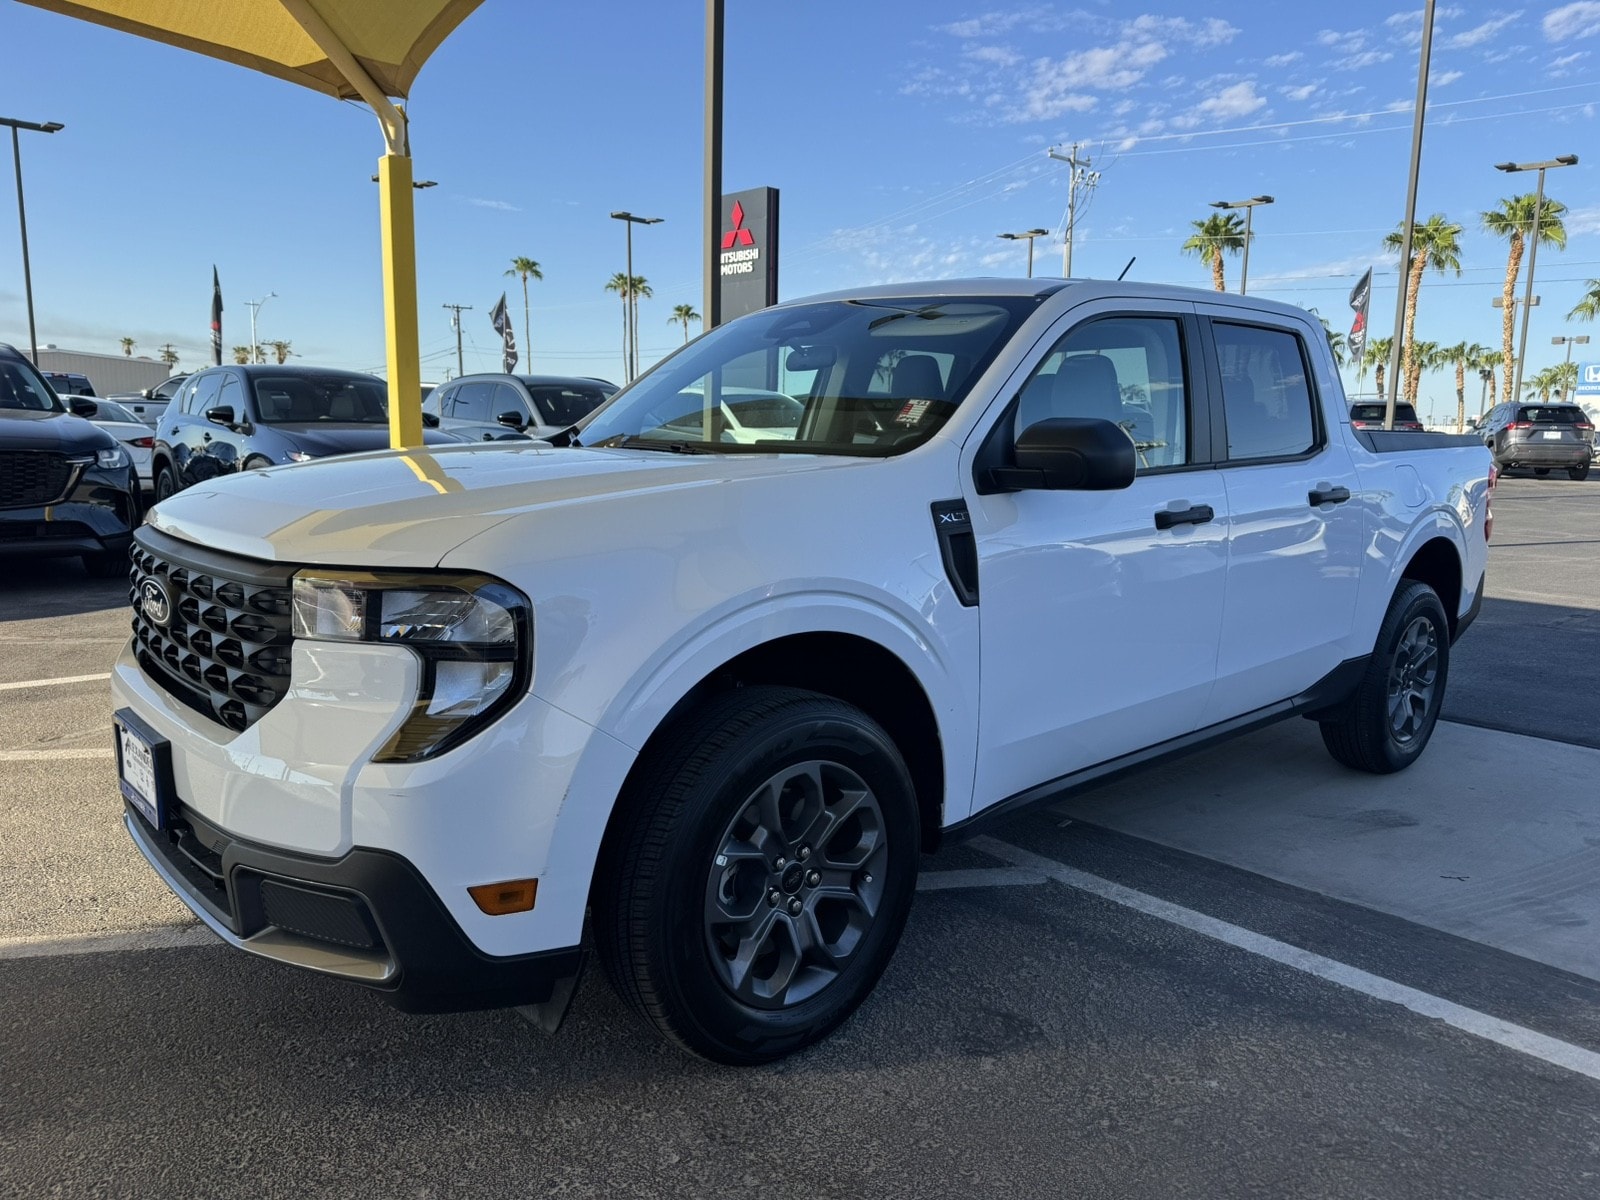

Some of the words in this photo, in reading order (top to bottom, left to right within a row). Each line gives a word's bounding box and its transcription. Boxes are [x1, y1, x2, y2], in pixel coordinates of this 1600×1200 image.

[720, 248, 759, 264] ITSUBISHI
[720, 261, 753, 276] MOTORS
[144, 584, 164, 618] Ford
